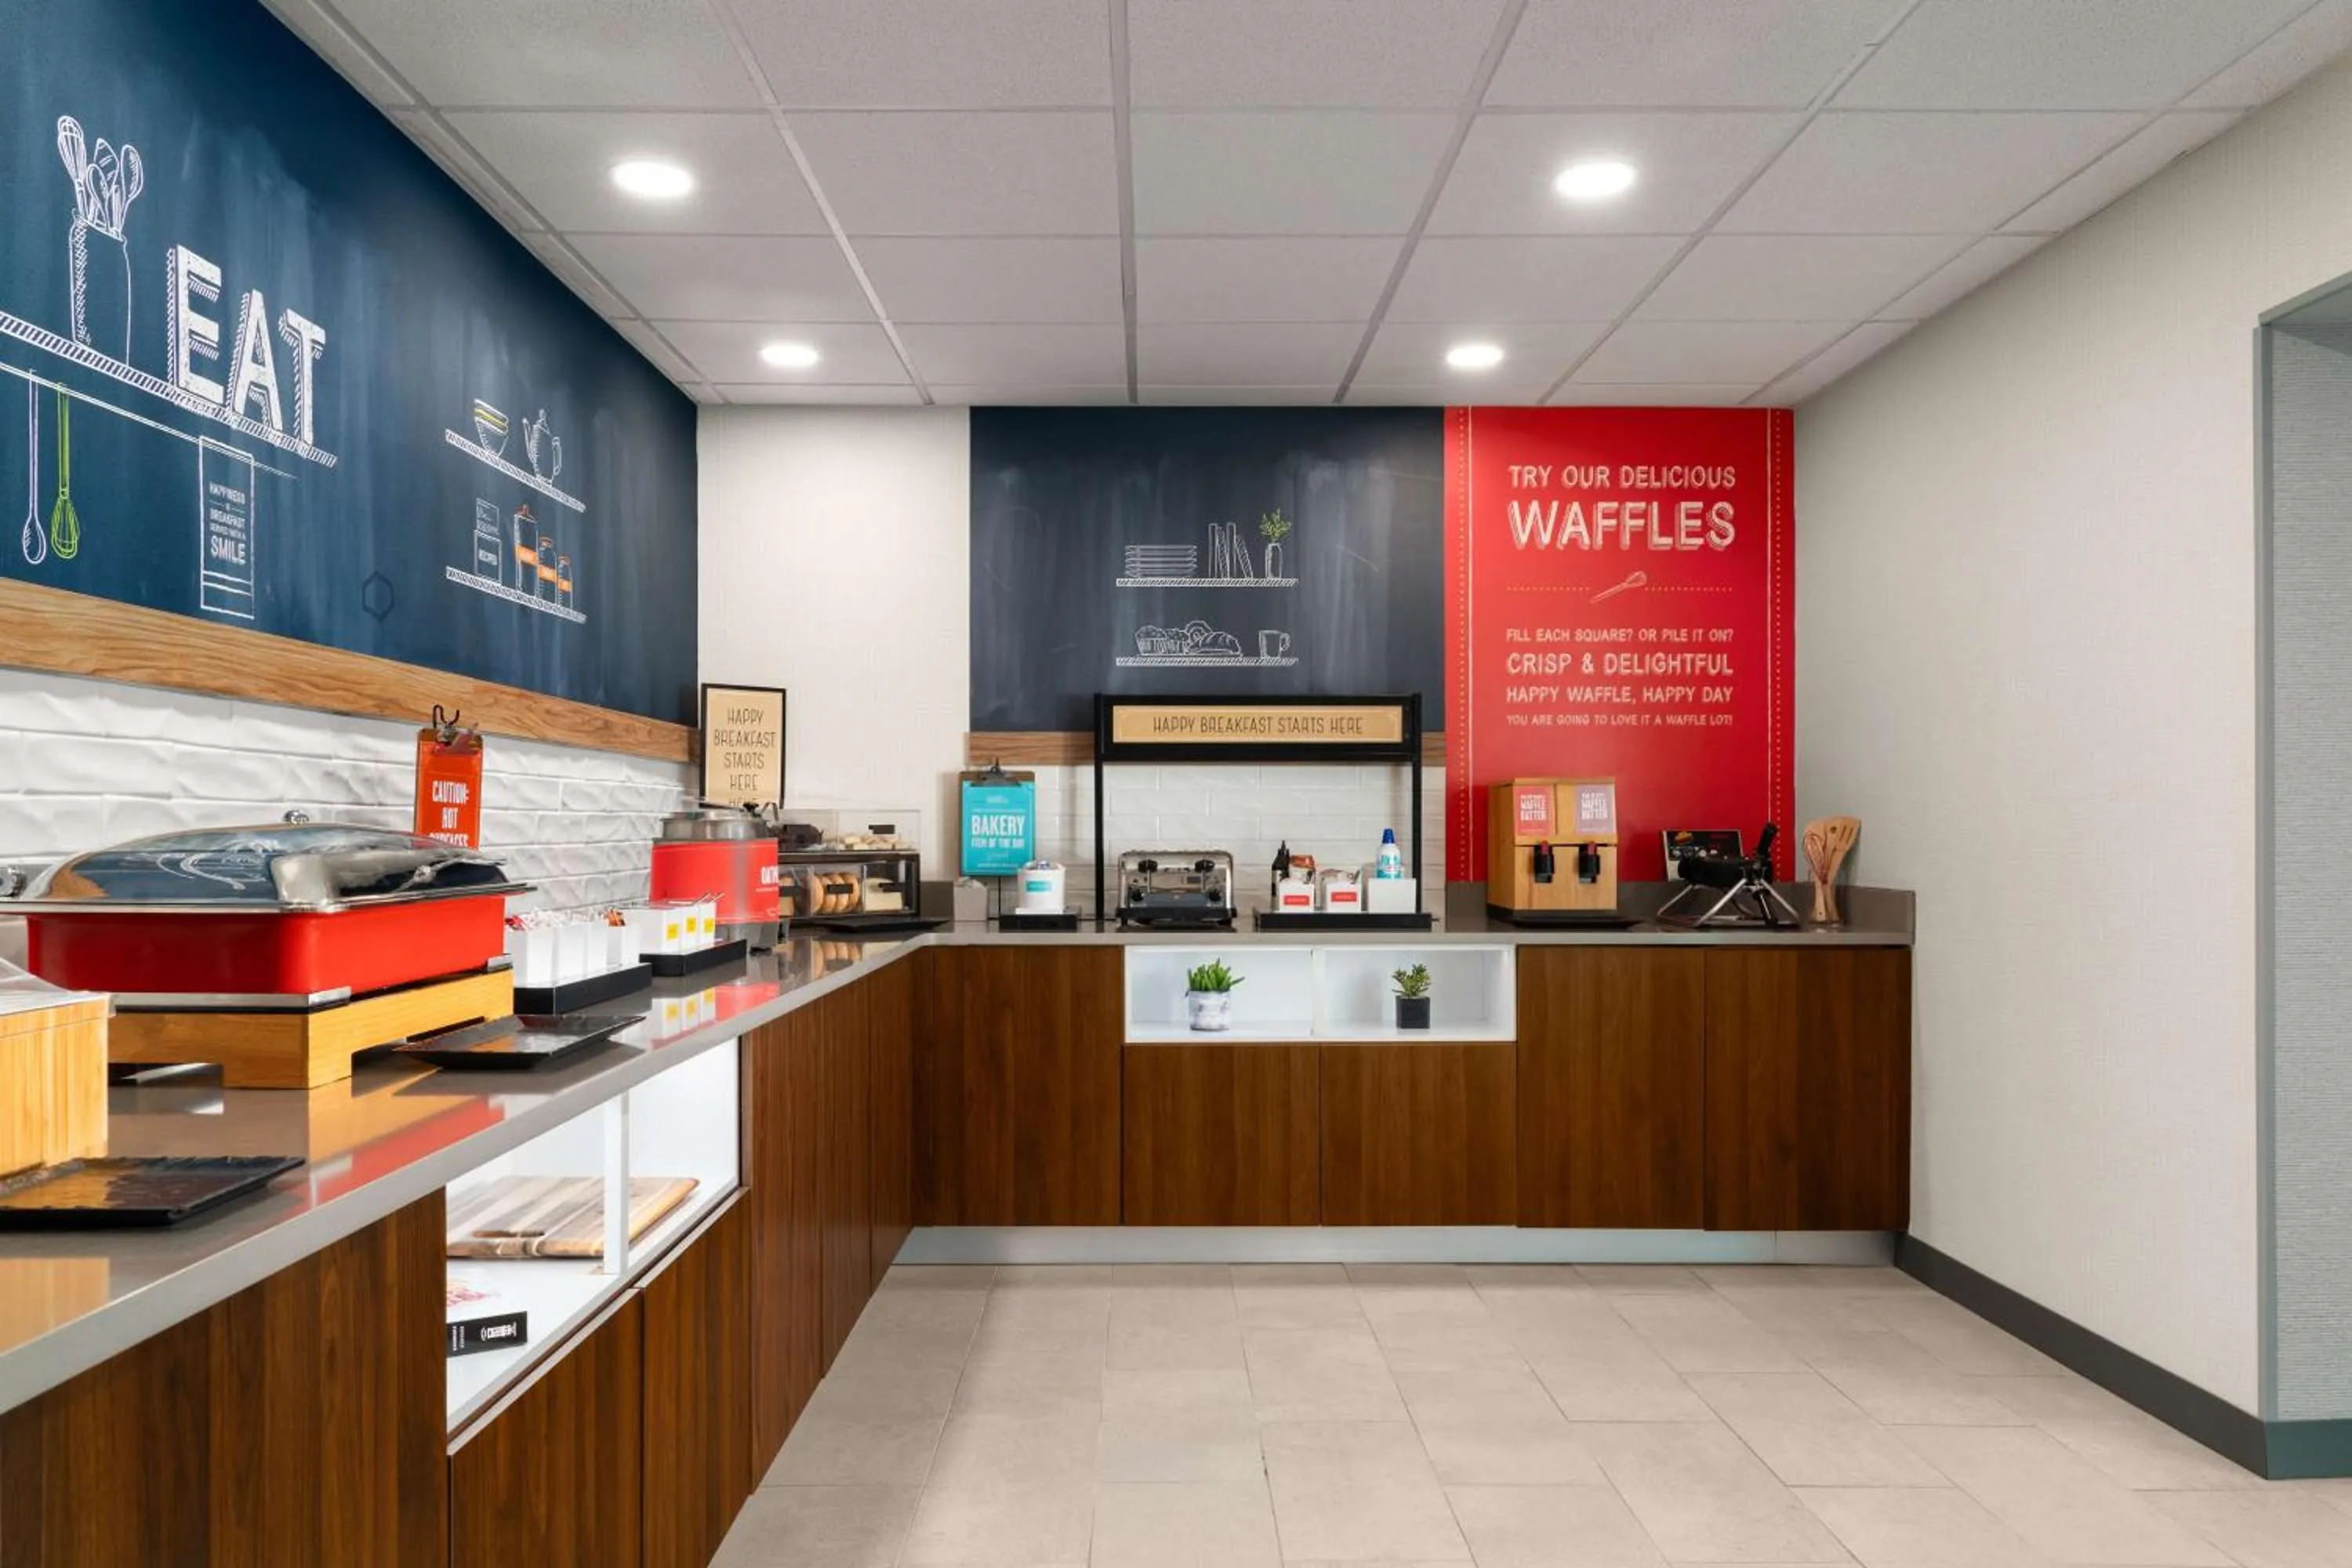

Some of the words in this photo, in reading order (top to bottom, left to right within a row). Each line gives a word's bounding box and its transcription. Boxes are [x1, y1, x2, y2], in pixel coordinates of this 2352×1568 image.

[167, 244, 326, 446] EAT
[1508, 465, 1552, 488] TRY
[1562, 465, 1610, 488] OUR
[1620, 465, 1736, 489] DELICIOUS
[1507, 500, 1736, 550] WAFFLES
[210, 535, 246, 564] SMILE
[1506, 628, 1531, 642] FILL
[1536, 628, 1570, 642] EACH
[1574, 628, 1634, 642] SQUARE?
[1639, 628, 1657, 642] OR
[1662, 628, 1688, 642] PILE
[1693, 628, 1704, 642] IT
[1708, 628, 1734, 642] ON?
[1506, 652, 1572, 676] CRISP
[1581, 652, 1595, 673] &
[1603, 653, 1734, 675] DELIGHTFUL
[1506, 686, 1559, 703] HAPPY
[1567, 686, 1637, 705] WAFFLE,
[1642, 686, 1696, 703] HAPPY
[1702, 686, 1734, 703] DAY
[727, 707, 764, 725] HAPPY
[1152, 716, 1195, 735] HAPPY
[1200, 716, 1273, 735] BREAKFAST
[1277, 716, 1325, 735] STARTS
[1330, 716, 1363, 735] HERE
[1506, 714, 1528, 726] YOU
[1531, 714, 1553, 726] ARE
[1556, 714, 1590, 726] GOING
[1594, 714, 1608, 726] TO
[1611, 714, 1638, 726] LOVE
[1641, 714, 1651, 726] IT
[1654, 714, 1662, 726] A
[1666, 714, 1707, 726] WAFFLE
[1710, 714, 1733, 726] LOT!
[713, 728, 776, 749] BREAKFAST
[724, 751, 764, 769] STARTS
[432, 780, 470, 805] CAUTION:
[730, 774, 758, 791] HERE
[441, 807, 459, 829] HOT
[971, 815, 1026, 837] BAKERY
